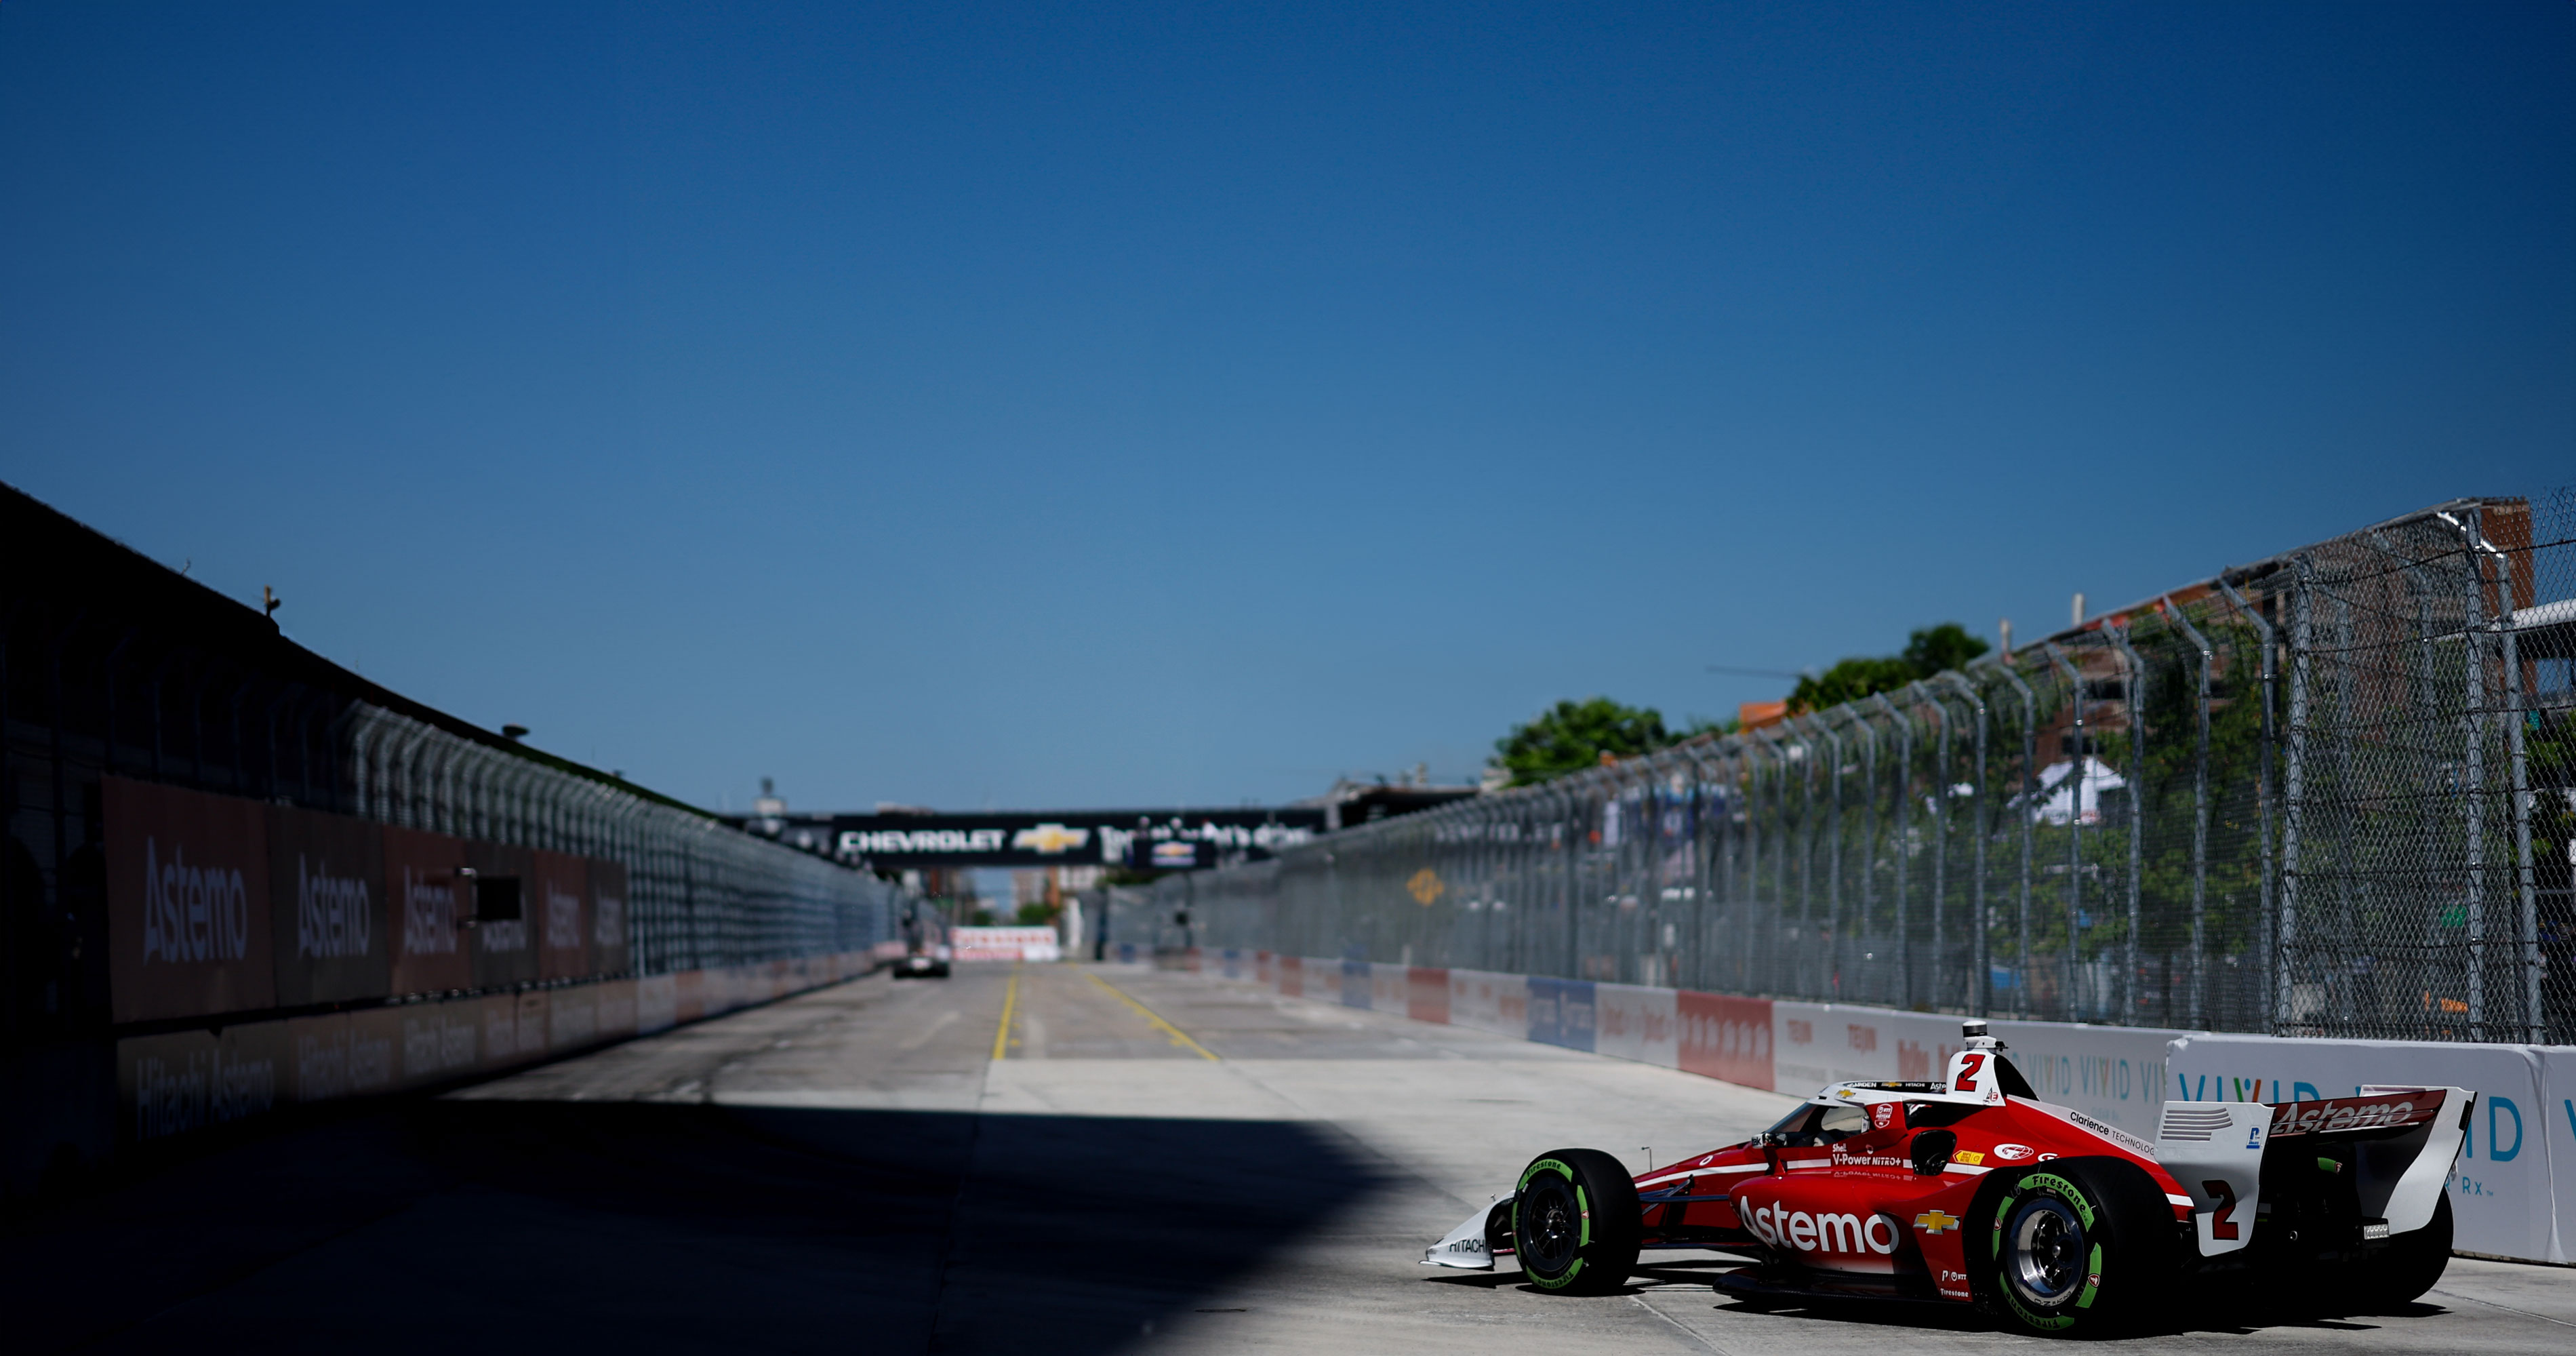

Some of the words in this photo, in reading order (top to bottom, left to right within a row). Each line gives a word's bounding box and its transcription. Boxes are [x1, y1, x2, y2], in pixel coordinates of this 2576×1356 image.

[839, 829, 1006, 854] CHEVROLET
[143, 835, 248, 967] Astemo
[298, 852, 371, 962] Astemo
[1955, 1054, 1986, 1092] 2
[2080, 1055, 2130, 1100] VIVID
[2070, 1111, 2109, 1136] Clarience
[2271, 1101, 2413, 1135] Astemo
[1832, 1143, 1847, 1153] Shell
[1832, 1154, 1871, 1165] V-Power
[1527, 1161, 1561, 1178] Firestone
[2032, 1176, 2087, 1212] Firestone
[2202, 1180, 2239, 1240] 2
[1740, 1196, 1899, 1254] Astemo
[1940, 1288, 1969, 1297] Firestone
